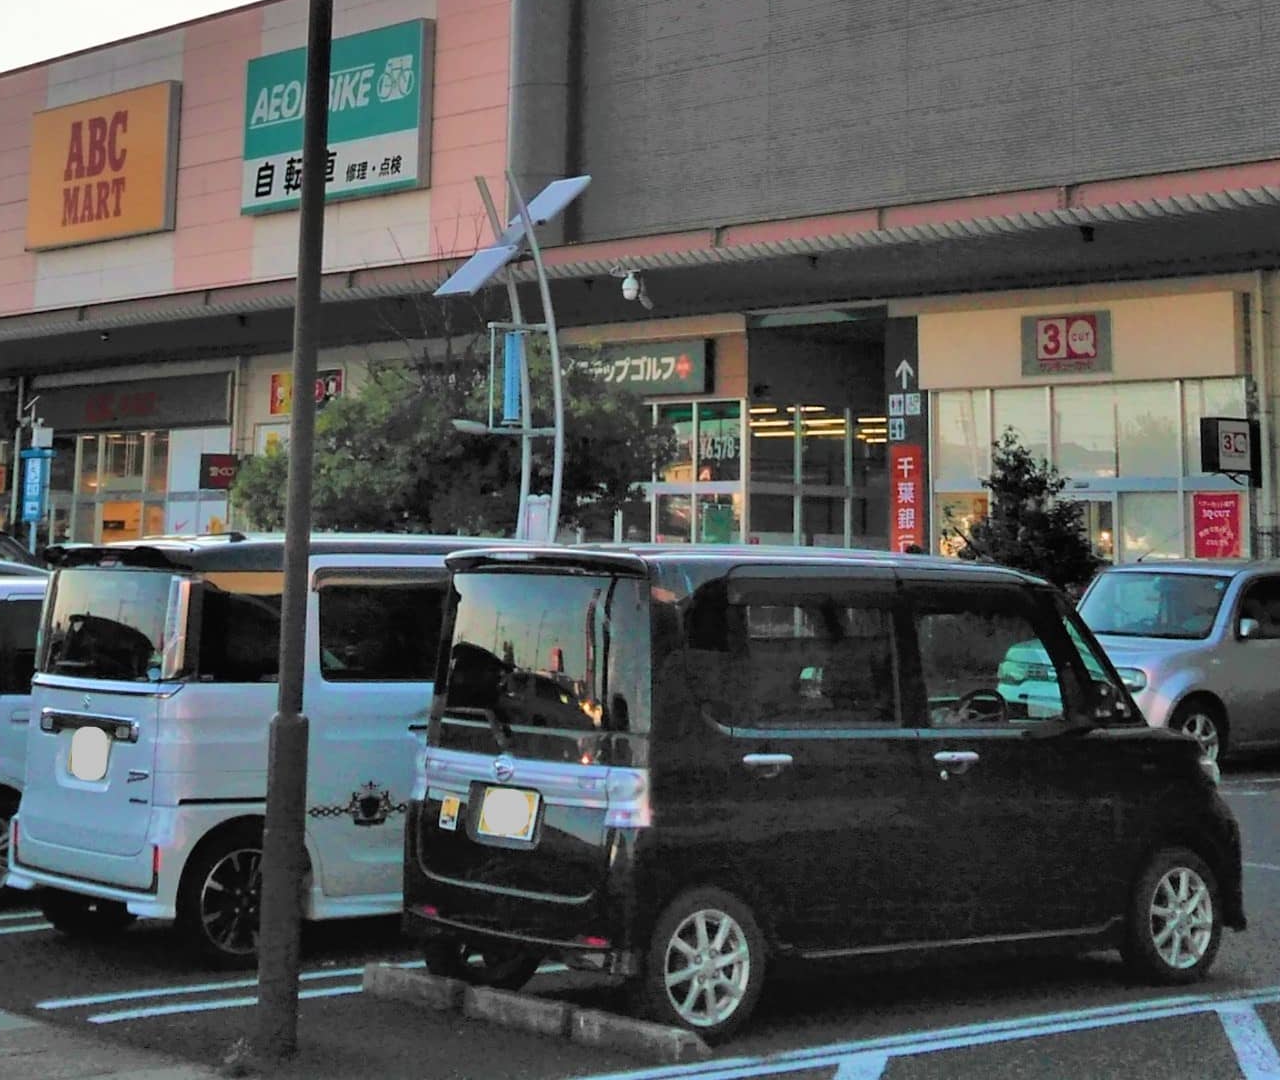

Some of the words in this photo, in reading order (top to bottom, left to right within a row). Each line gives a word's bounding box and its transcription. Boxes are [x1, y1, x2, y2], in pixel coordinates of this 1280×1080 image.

[250, 65, 375, 127] AEOIKE
[63, 110, 129, 181] ABC
[61, 176, 127, 227] MART
[896, 456, 915, 552] 千葉銀行
